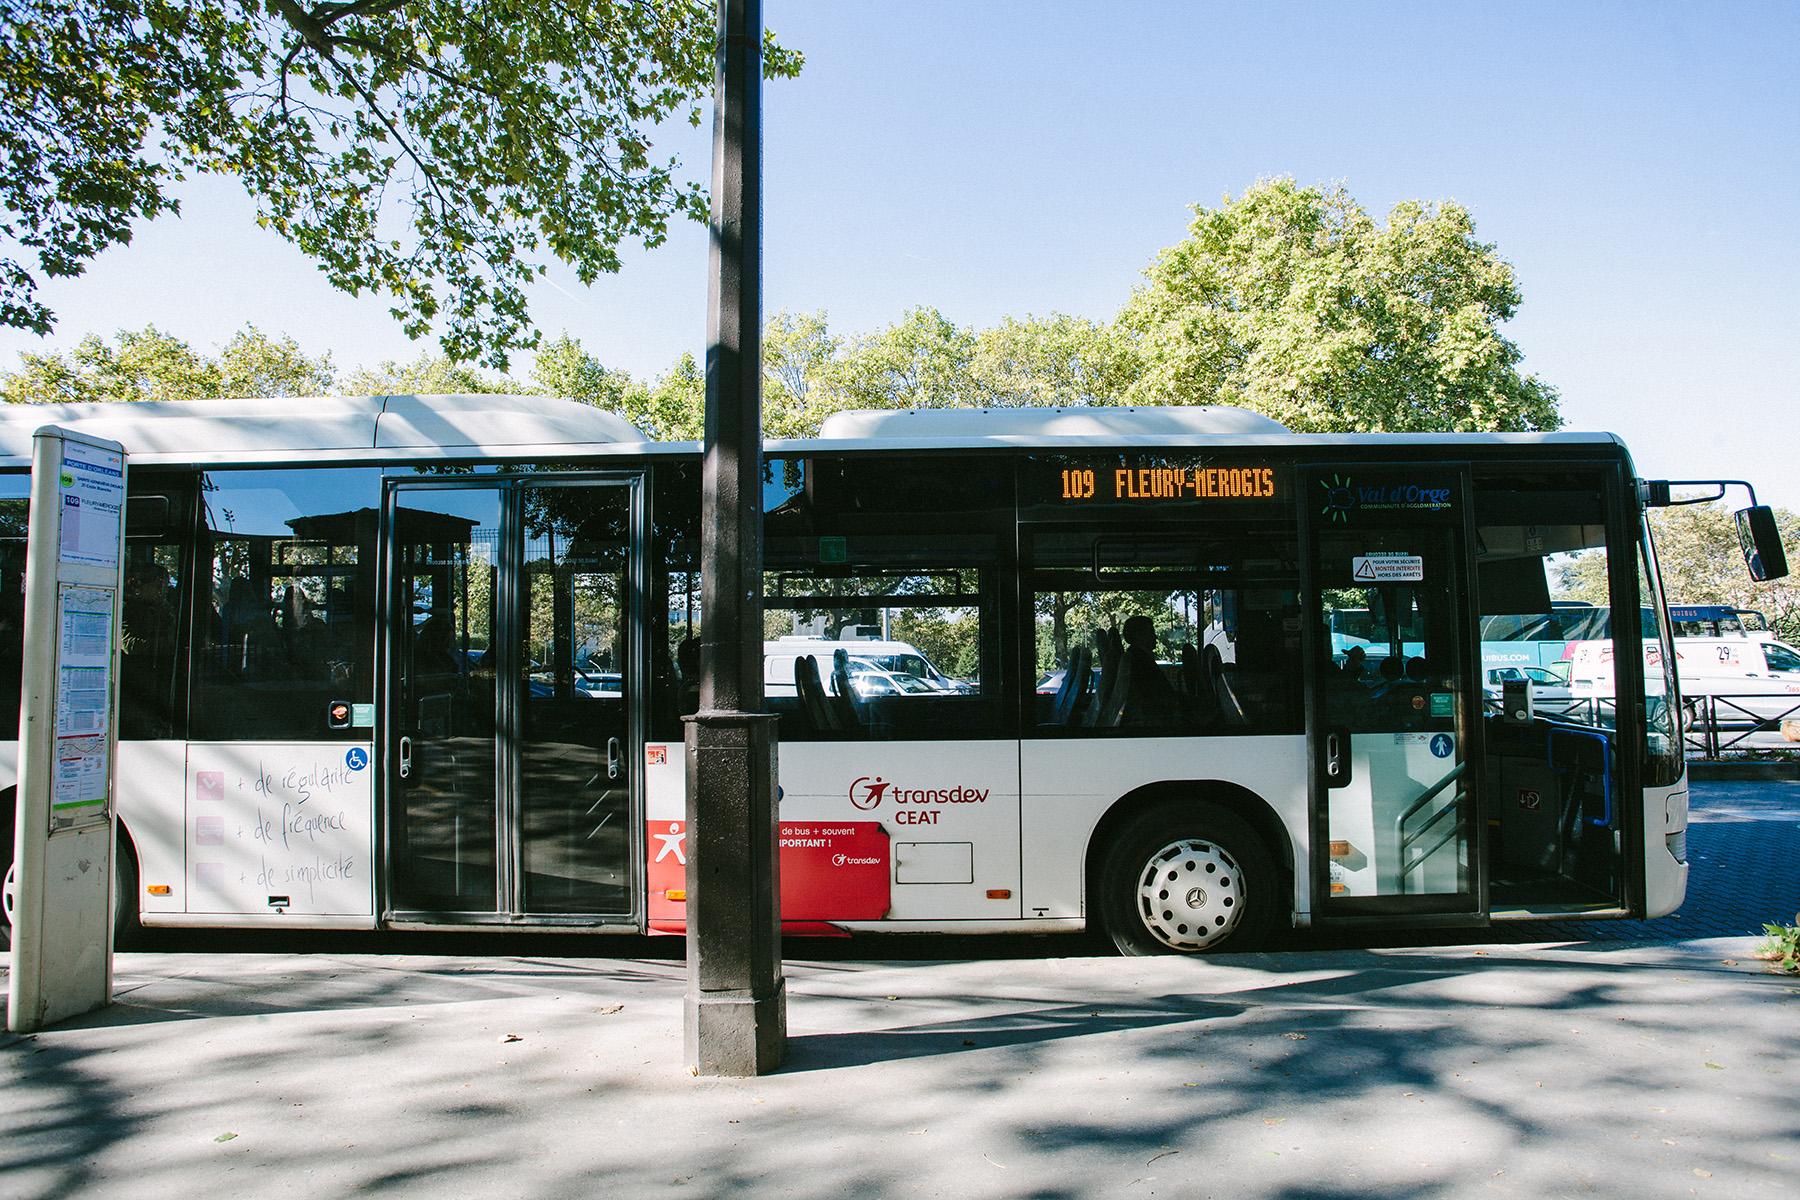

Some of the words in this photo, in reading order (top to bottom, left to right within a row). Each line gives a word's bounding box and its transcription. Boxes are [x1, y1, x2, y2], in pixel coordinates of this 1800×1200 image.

[1062, 469, 1095, 498] 109
[1115, 468, 1275, 498] FLEURY-MEROGIS
[1359, 486, 1386, 503] Val
[1390, 484, 1451, 511] d'Orge
[1482, 654, 1530, 662] UIBUS.COM
[255, 759, 273, 799] de
[892, 785, 990, 804] transdev
[254, 807, 273, 846] de
[282, 802, 347, 851] fréquence
[895, 810, 941, 825] CEAT
[781, 827, 793, 836] de
[795, 827, 811, 836] bus
[822, 827, 855, 836] souvent
[847, 857, 881, 865] transdev
[256, 854, 275, 894] de
[283, 852, 354, 905] simplicité
